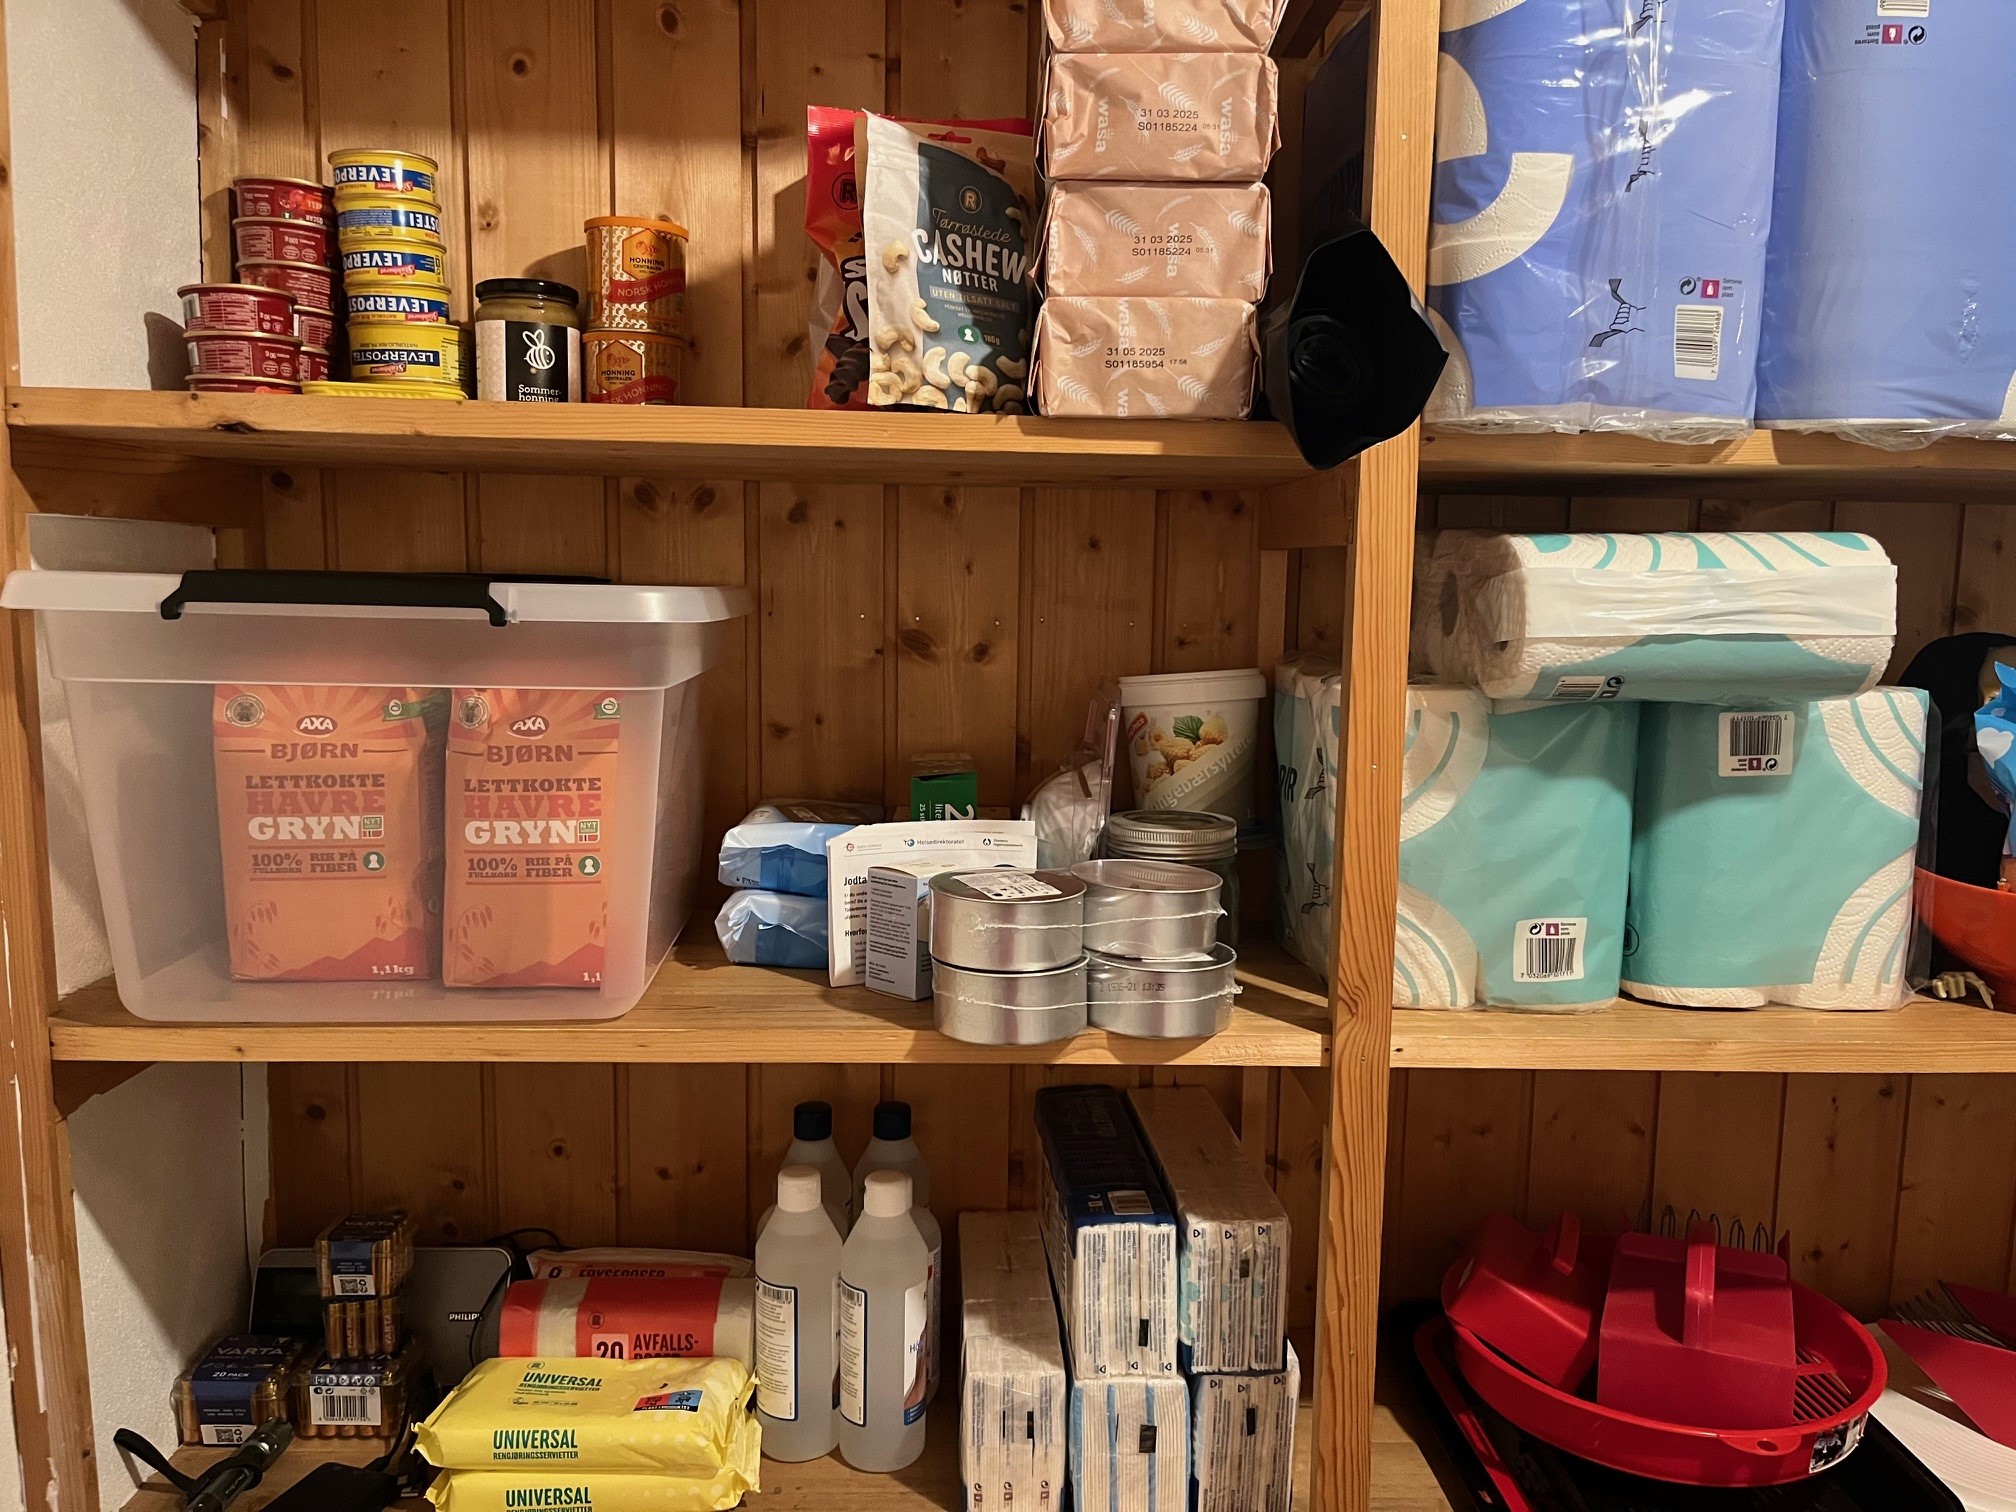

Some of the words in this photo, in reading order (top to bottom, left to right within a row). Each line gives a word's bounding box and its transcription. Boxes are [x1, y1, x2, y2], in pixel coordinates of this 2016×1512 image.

[1140, 108, 1152, 118] 31
[1156, 108, 1170, 119] 03
[1172, 108, 1199, 119] 2025
[1095, 97, 1108, 153] wasa
[1137, 121, 1198, 132] S01185224
[1219, 97, 1232, 156] wasa
[932, 207, 1012, 243] Tørrøstede
[1134, 236, 1146, 244] 31
[1150, 236, 1163, 244] 03
[1166, 235, 1193, 244] 2025
[910, 228, 1027, 285] CASHEW
[1131, 247, 1191, 257] S01185224
[629, 256, 665, 267] HONNING
[942, 268, 998, 292] NØTTER
[617, 284, 652, 298] NORSK
[931, 288, 956, 300] UTEN
[1106, 348, 1119, 356] 31
[1122, 348, 1136, 356] 05
[1138, 347, 1166, 356] 2025
[1104, 360, 1164, 369] S01185954
[601, 369, 636, 377] HONNING
[518, 384, 562, 396] Sommer-
[300, 717, 333, 730] AXA
[512, 717, 546, 731] AXA
[270, 742, 359, 762] BJØRN
[486, 744, 574, 766] BJØRN
[245, 773, 385, 789] LETTKOKTE
[464, 777, 602, 793] LETTKOKTE
[246, 790, 386, 814] HAVRE
[464, 794, 602, 818] HAVRE
[935, 803, 944, 820] lite
[945, 803, 975, 820] 2
[248, 815, 361, 840] GRYN
[464, 820, 576, 844] GRYN
[252, 853, 303, 867] 100%
[310, 852, 335, 861] RIK
[338, 849, 357, 861] PÅ
[468, 858, 518, 871] 100%
[525, 857, 551, 866] RIK
[555, 854, 574, 866] PÅ
[310, 863, 358, 872] FIBER
[525, 868, 573, 878] FIBER
[843, 876, 867, 886] Jodta
[844, 928, 867, 937] Hvorfo
[217, 1347, 284, 1355] VARTA
[596, 1341, 625, 1360] 20
[633, 1333, 699, 1352] AVFALLS-
[523, 1372, 603, 1387] UNIVERSAL
[493, 1429, 578, 1449] UNIVERSAL
[493, 1451, 579, 1460] RENGJØRINGSSERVIETTER
[506, 1486, 592, 1507] UNIVERSAL
